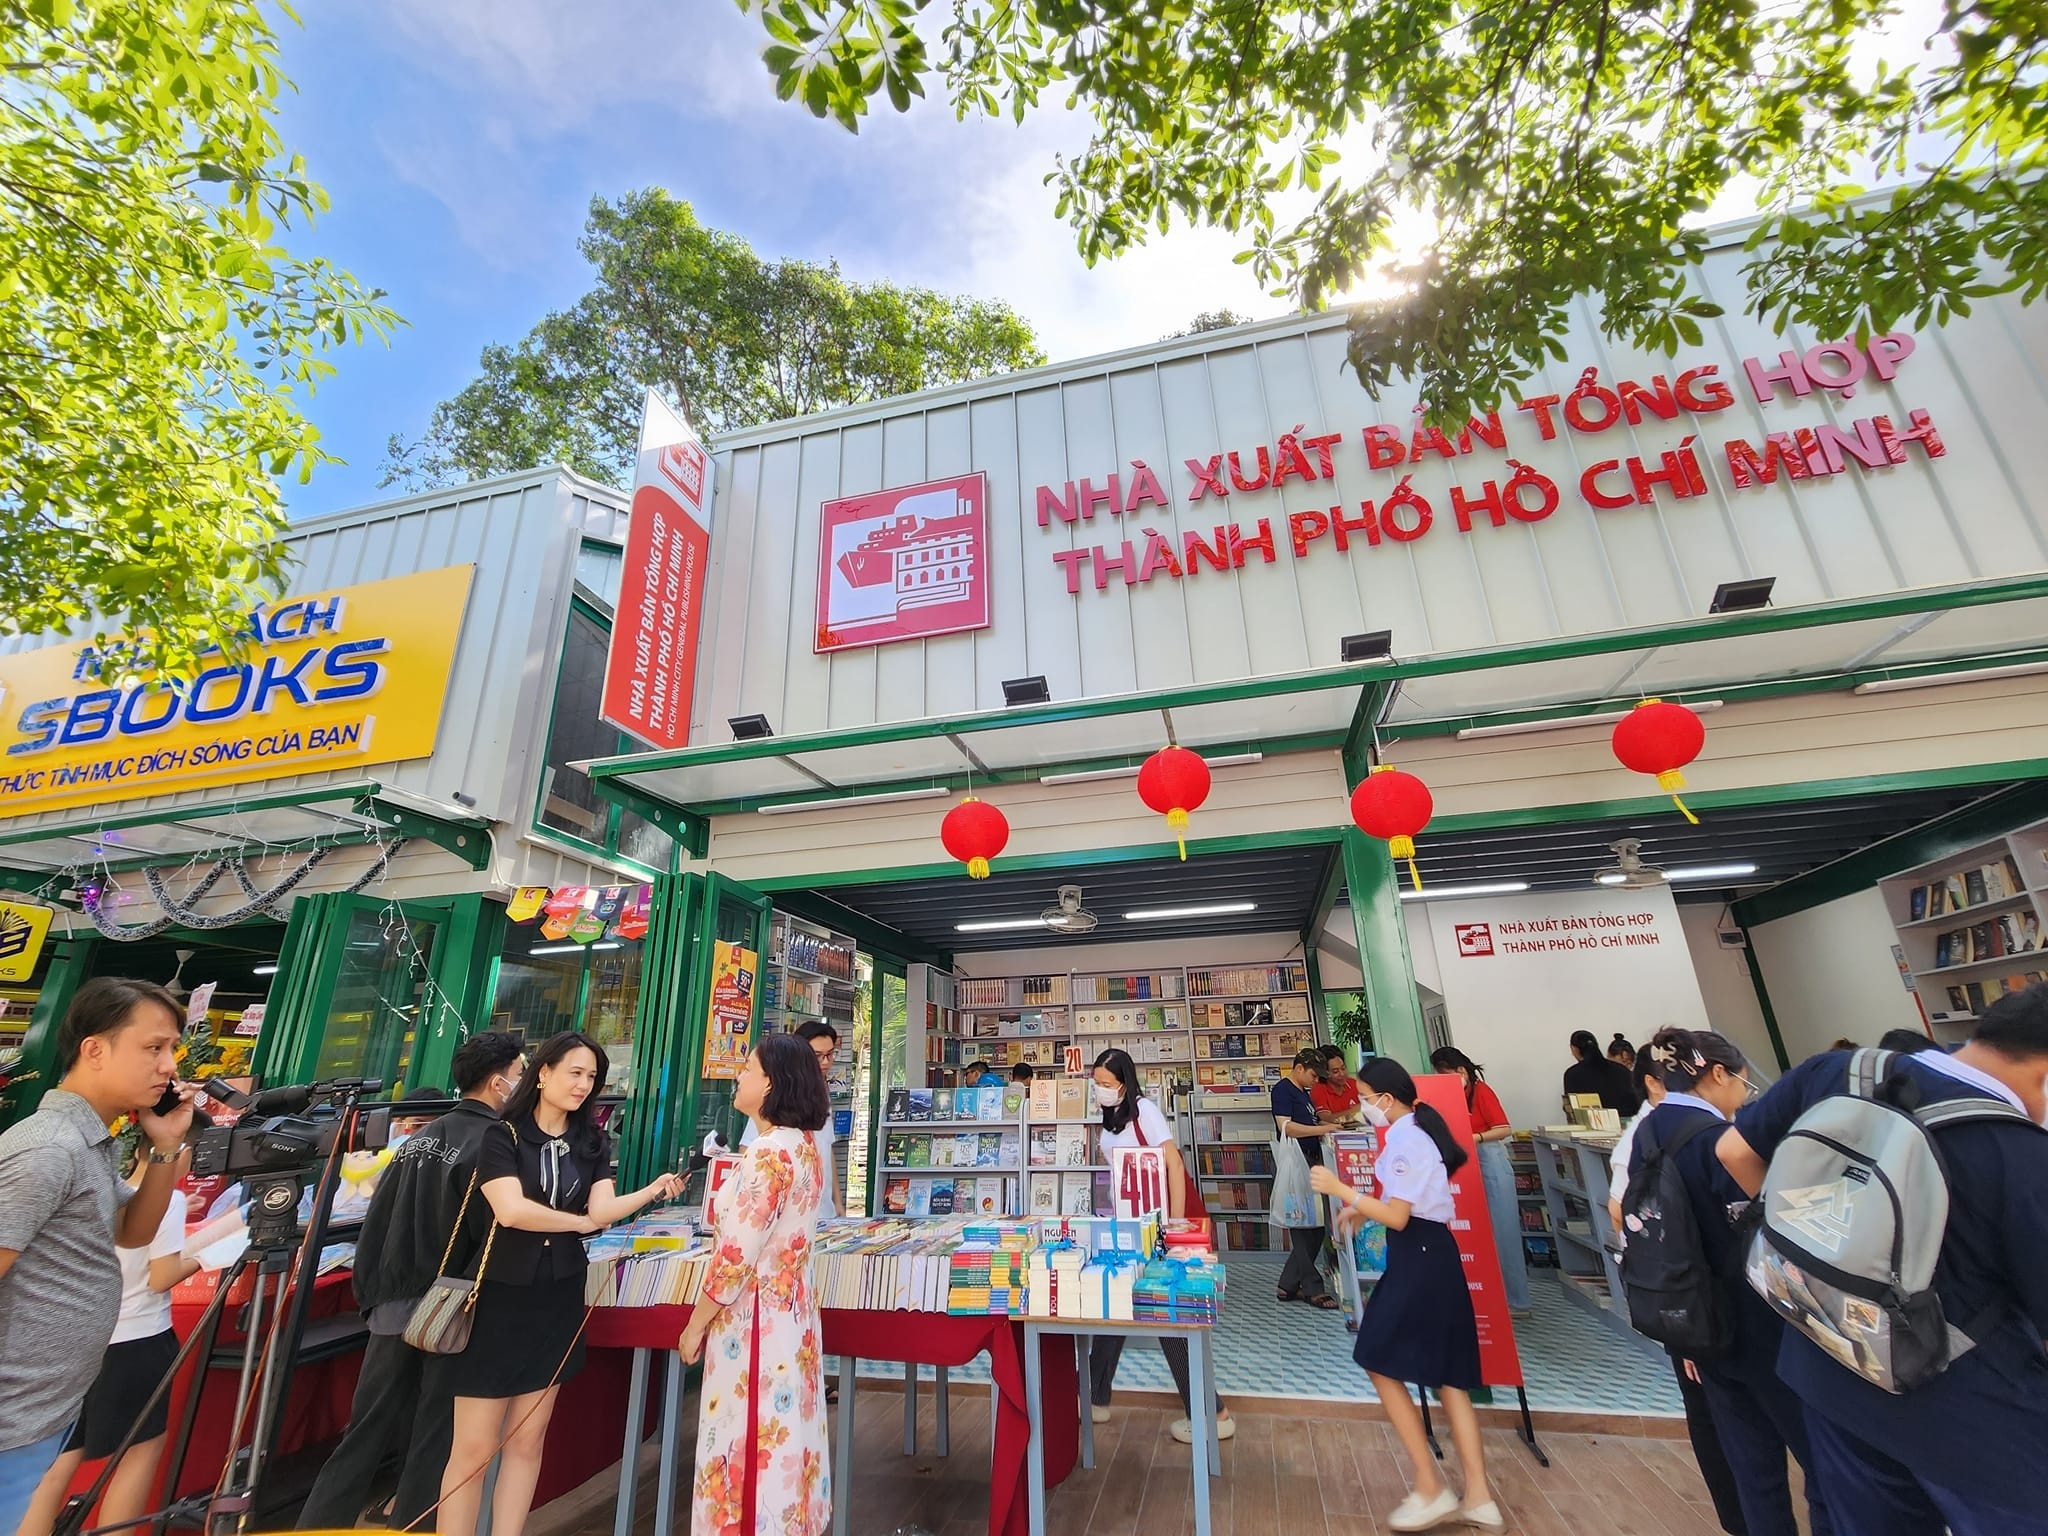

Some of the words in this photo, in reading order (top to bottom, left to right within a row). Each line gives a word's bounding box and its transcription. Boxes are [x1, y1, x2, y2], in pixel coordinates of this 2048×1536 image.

[1036, 459, 1169, 527] NHÀ
[1185, 424, 1342, 500] XUẤT
[1362, 403, 1507, 470] BẢN
[1519, 365, 1735, 441] TỔNG
[1743, 332, 1916, 402] HỢP
[1053, 518, 1276, 594] THÀNH
[1290, 474, 1434, 558] PHỐ
[1449, 458, 1560, 533] HỒ
[1579, 434, 1708, 509] CHÍ
[1724, 408, 1947, 489] MINH
[652, 512, 668, 550] HỢP
[644, 547, 661, 594] TỔNG
[669, 528, 684, 574] MINH
[687, 541, 695, 571] HOUSE
[666, 569, 680, 602] CHÍ
[680, 570, 693, 620] PUBLISHING
[640, 593, 657, 632] BẢN
[661, 600, 676, 631] HỒ
[635, 629, 652, 679] XUẤT
[657, 627, 672, 668] PHỐ
[676, 621, 687, 660] GENERAL
[674, 658, 682, 680] CITY
[7, 637, 390, 757] SBOOKS
[629, 679, 646, 720] NHÀ
[649, 668, 669, 729] THÀNH
[671, 680, 680, 706] MINH
[666, 723, 675, 740] HO
[669, 706, 677, 723] CHI
[50, 764, 90, 787] TỈNH
[90, 757, 134, 784] MỤC
[136, 747, 187, 775] ĐÍCH
[190, 732, 252, 765] SỐNG
[256, 726, 302, 757] CỦA
[307, 722, 360, 753] BẠN
[1499, 920, 1526, 934] NHÀ
[1528, 915, 1559, 933] XUẤT
[1562, 915, 1588, 931] BẢN
[1590, 911, 1625, 929] TỔNG
[1627, 912, 1654, 928] HỢP
[1503, 939, 1546, 953] THÀNH
[1548, 933, 1576, 951] PHỐ
[1578, 932, 1597, 949] HỒ
[1601, 932, 1622, 947] CHÍ
[1625, 932, 1660, 946] MINH
[1066, 1048, 1082, 1073] 20
[272, 1143, 297, 1153] SONY
[1120, 1152, 1161, 1218] 40
